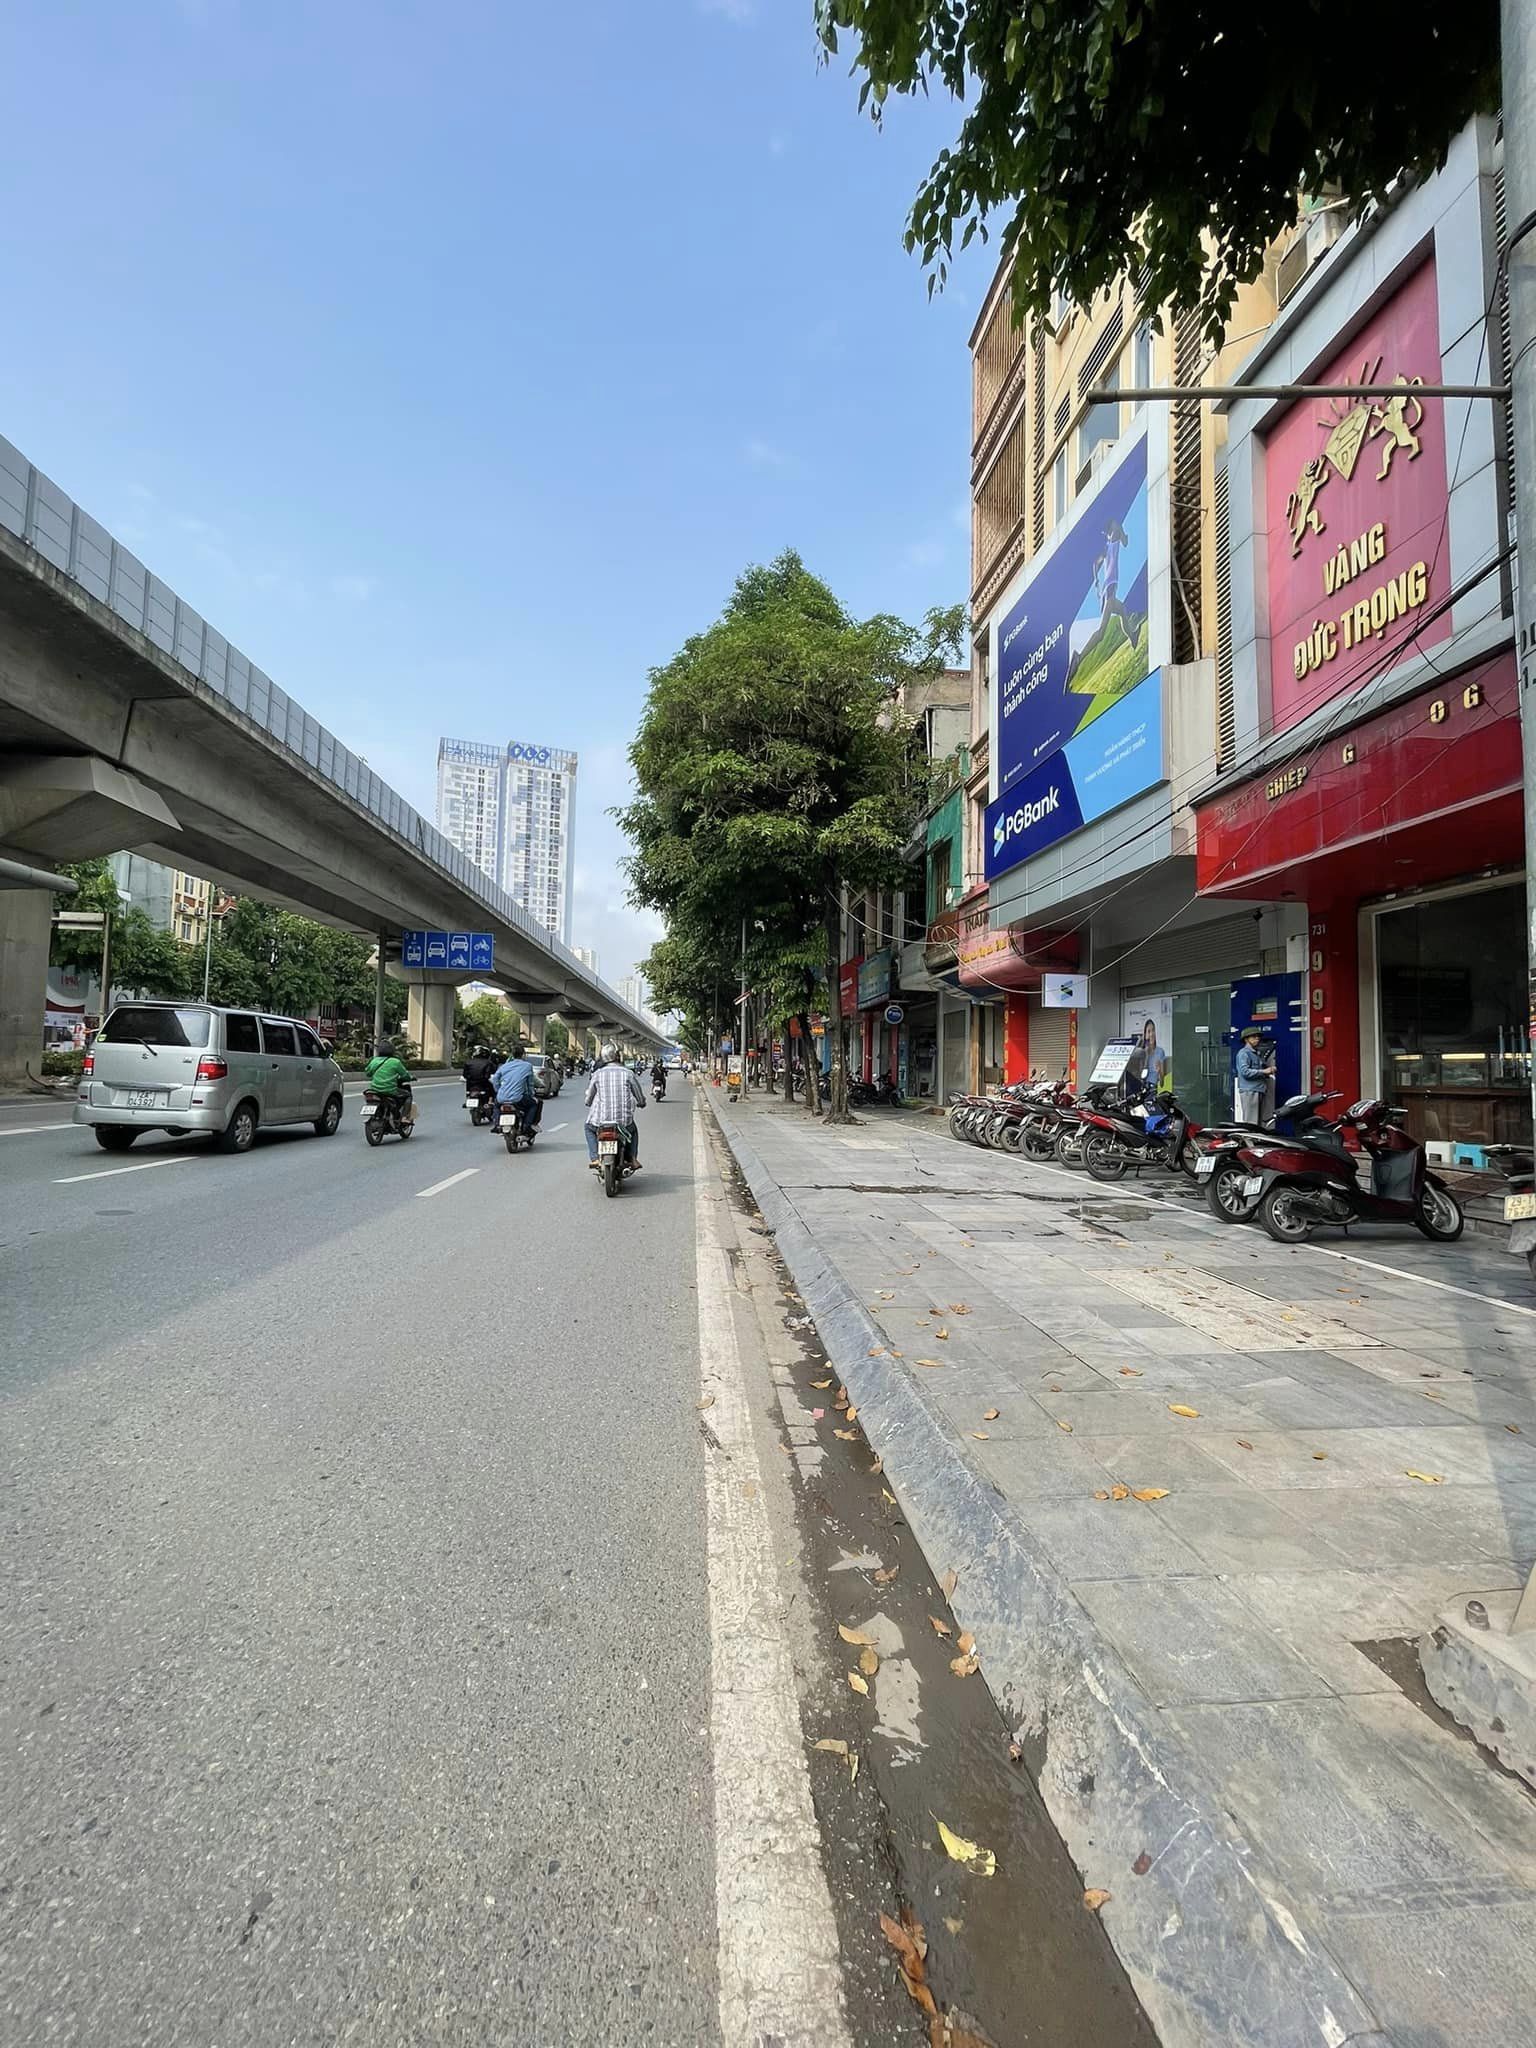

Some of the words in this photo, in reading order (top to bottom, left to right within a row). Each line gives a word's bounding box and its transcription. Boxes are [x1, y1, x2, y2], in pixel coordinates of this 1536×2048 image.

[1323, 523, 1385, 596] VÀNG
[1294, 620, 1338, 680] ĐỨC
[1340, 561, 1427, 649] TRỌNG
[1003, 668, 1023, 698] Luôn
[1022, 643, 1045, 675] cùng
[1044, 623, 1064, 653] bạn
[1003, 686, 1026, 718] thành
[1025, 664, 1049, 697] công
[1463, 683, 1479, 709] G
[1006, 785, 1060, 841] PGBank
[1311, 924, 1326, 935] 731
